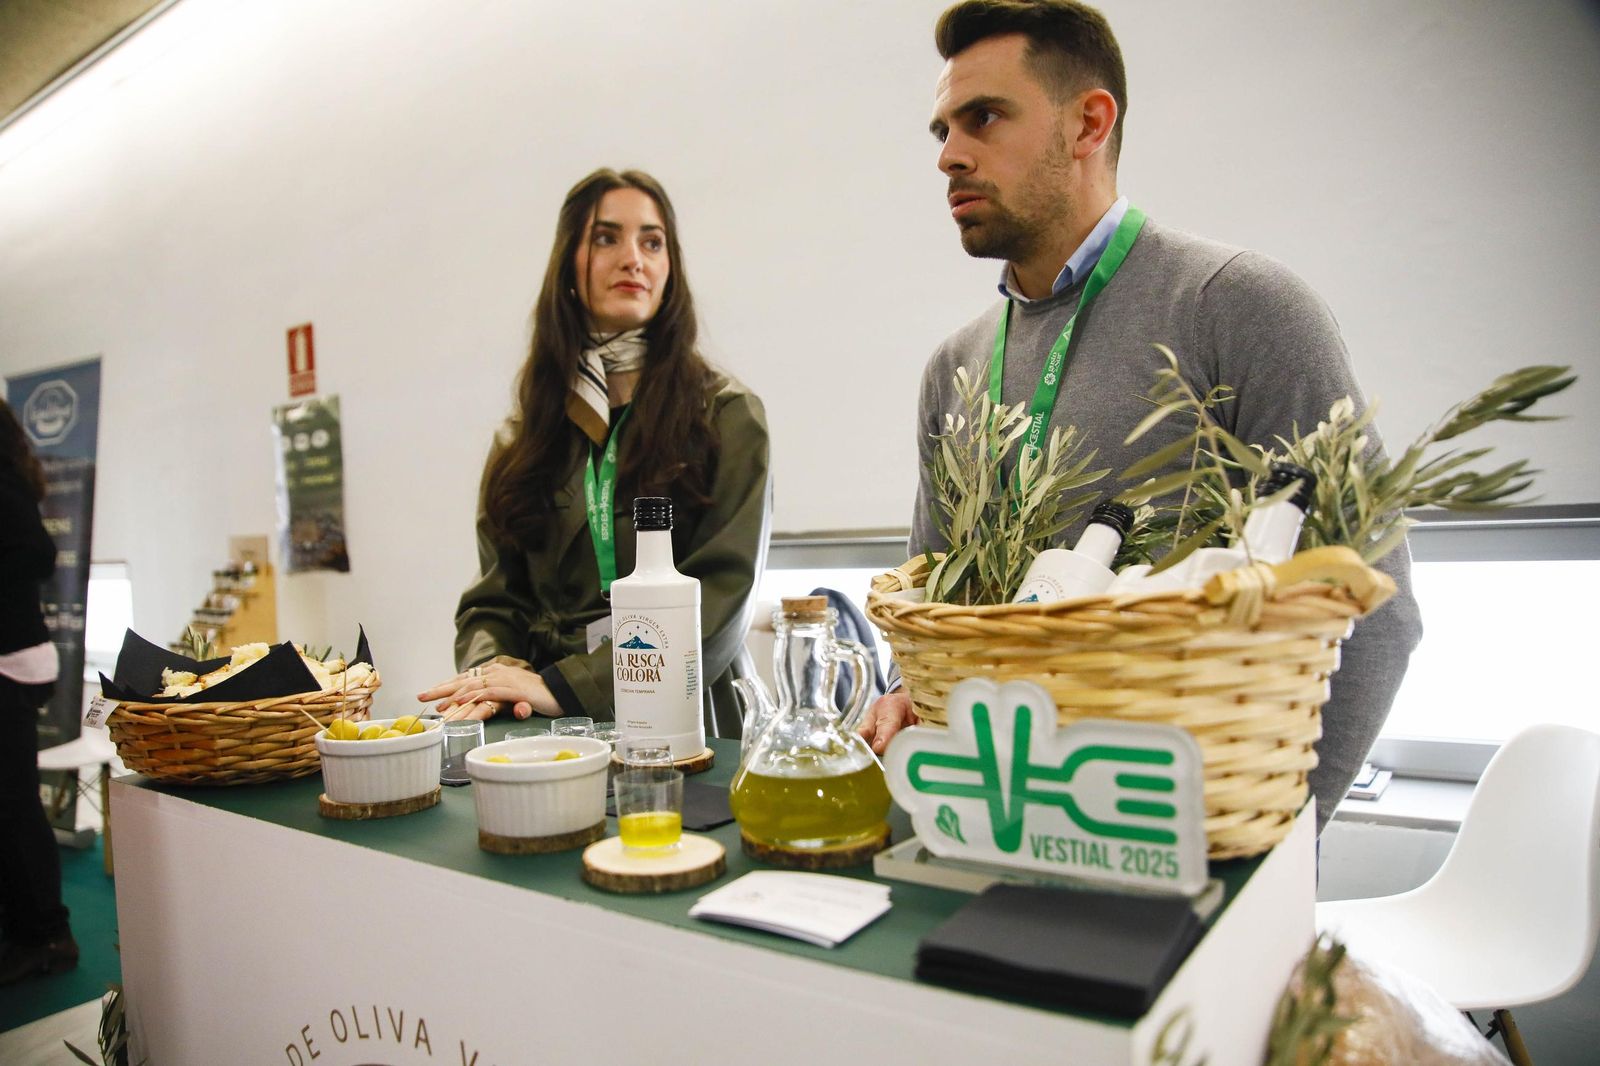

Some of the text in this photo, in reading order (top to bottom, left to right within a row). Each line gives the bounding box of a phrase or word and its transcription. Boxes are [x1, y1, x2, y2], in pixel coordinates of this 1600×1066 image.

[615, 651, 666, 668] LA RISCA
[1029, 833, 1180, 880] VESTIAL 2025
[329, 1004, 433, 1056] OLIVA
